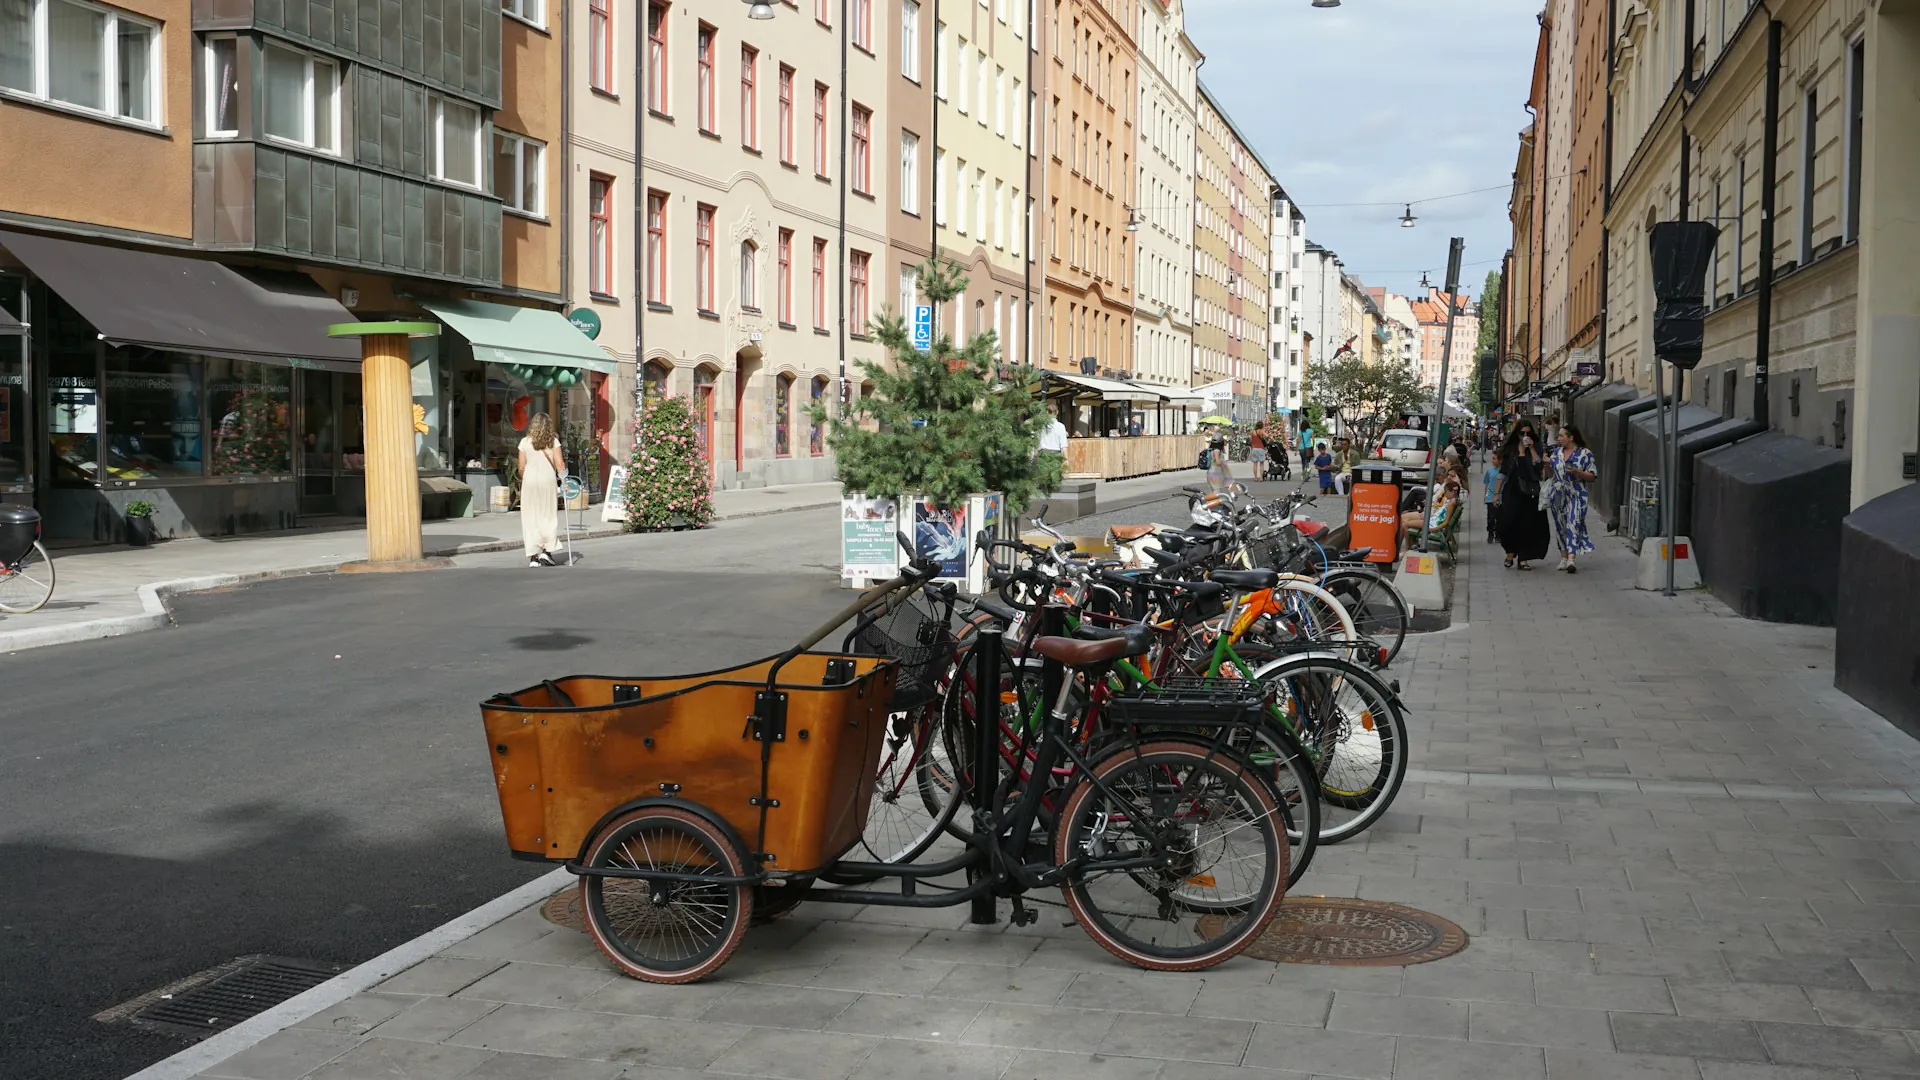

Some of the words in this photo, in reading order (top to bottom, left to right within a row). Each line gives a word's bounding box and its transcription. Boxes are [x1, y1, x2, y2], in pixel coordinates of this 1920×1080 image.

[919, 308, 928, 322] P
[1353, 513, 1368, 522] Här
[1369, 514, 1379, 522] är
[1379, 514, 1395, 524] jag!
